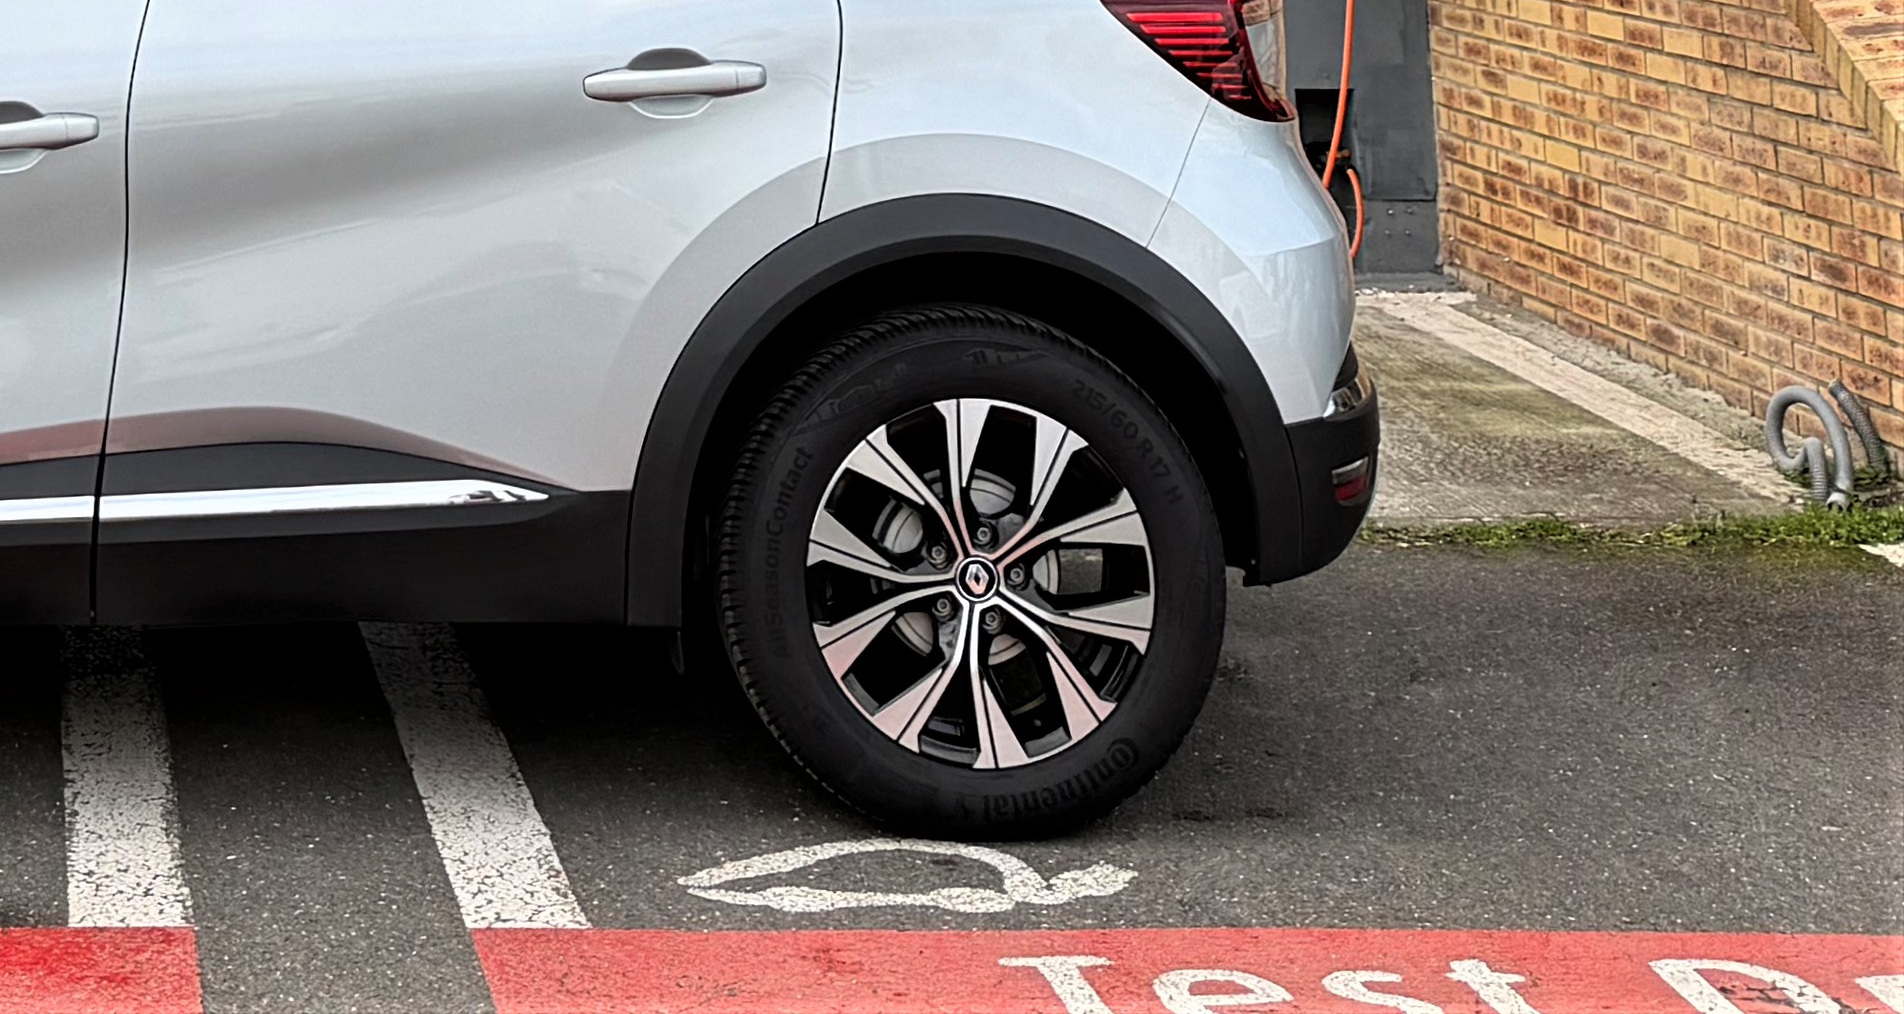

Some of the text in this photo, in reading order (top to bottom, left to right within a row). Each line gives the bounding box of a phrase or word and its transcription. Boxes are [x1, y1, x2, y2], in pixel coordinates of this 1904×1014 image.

[1070, 378, 1140, 440] 215/60
[1163, 484, 1186, 505] H
[998, 956, 1904, 1014] Test D
